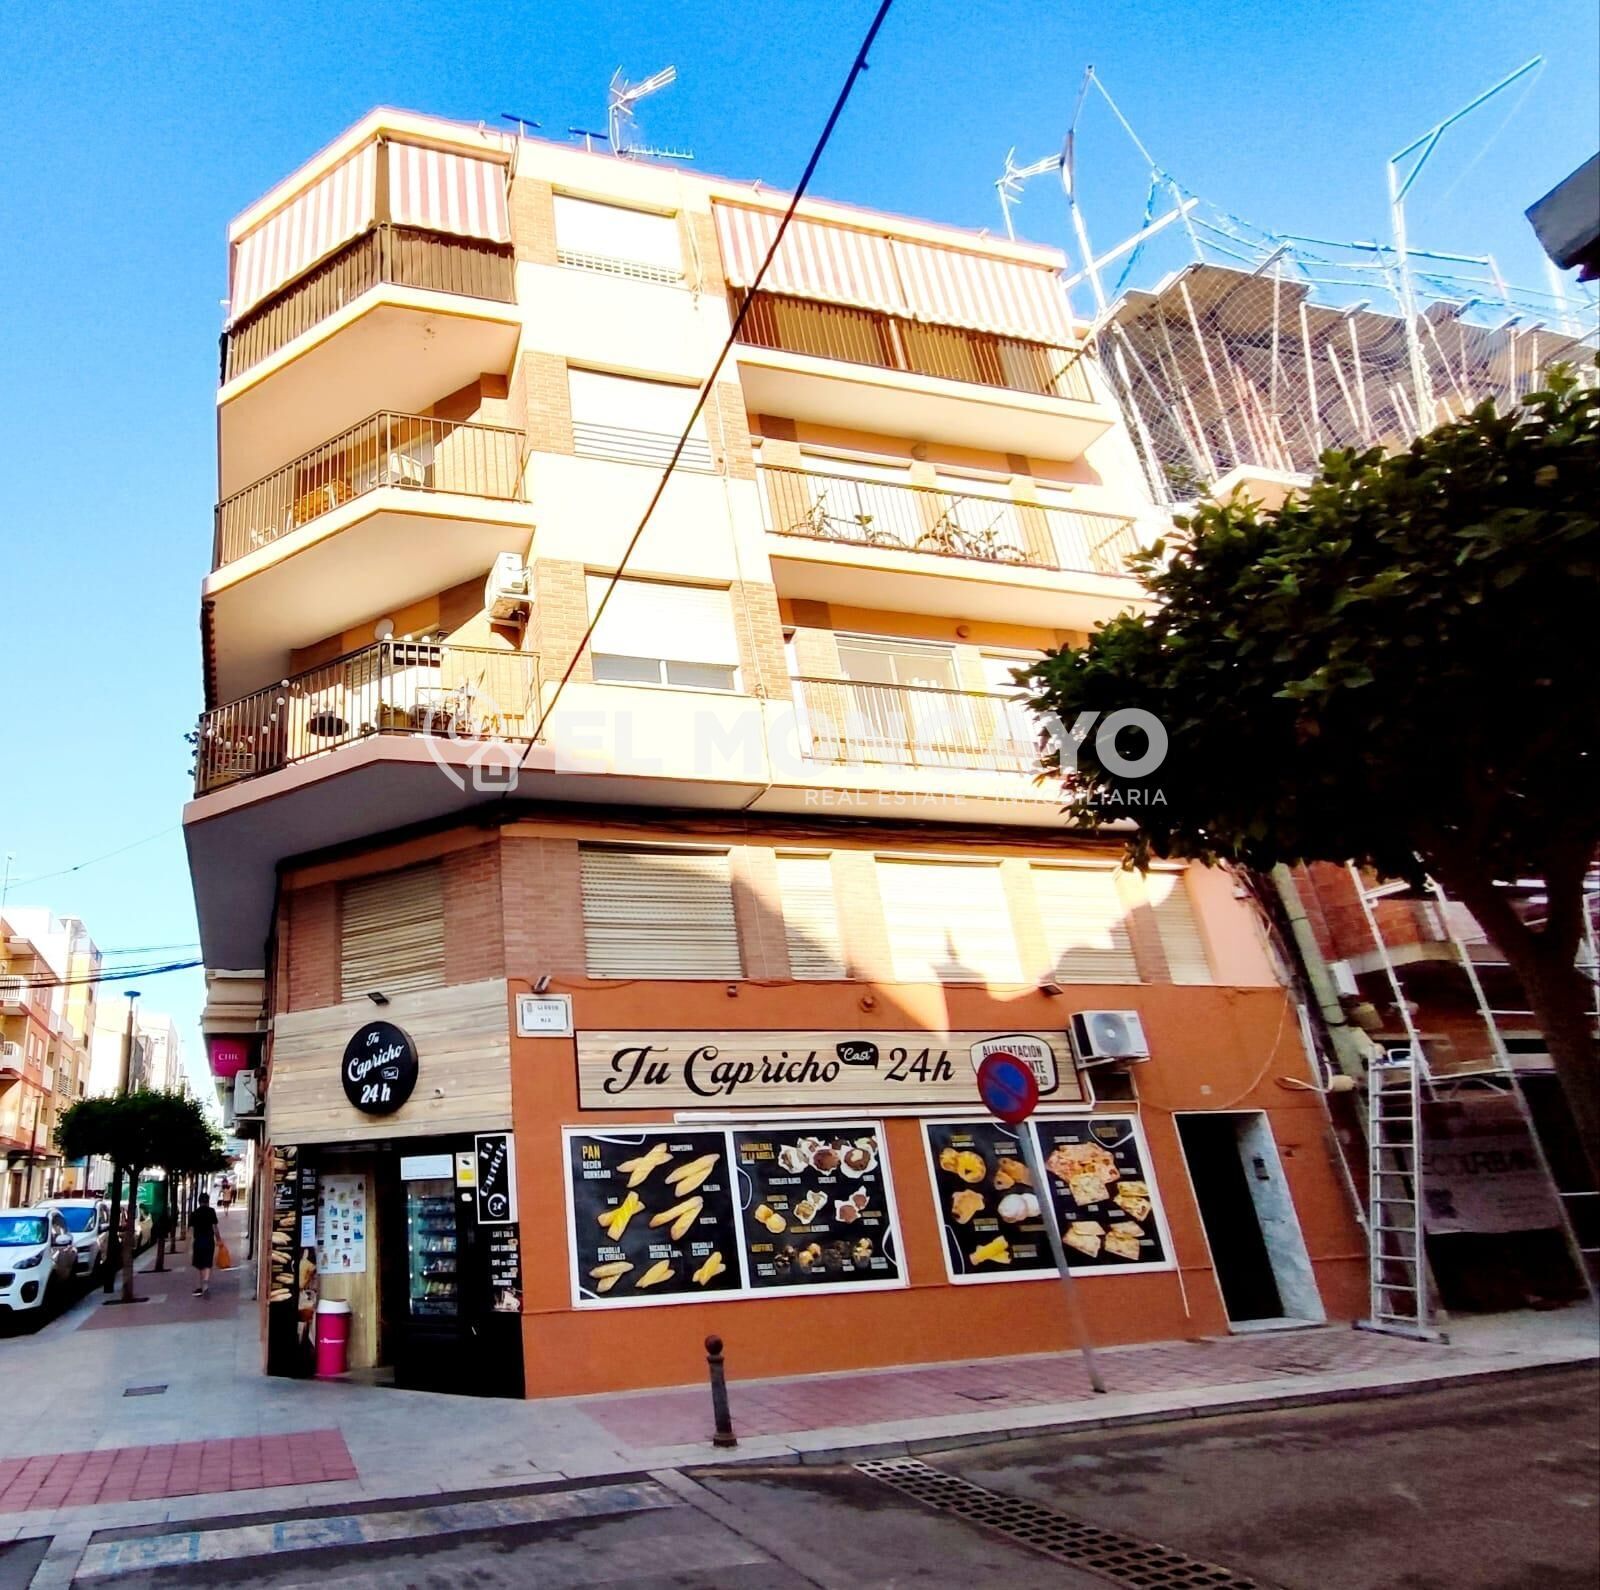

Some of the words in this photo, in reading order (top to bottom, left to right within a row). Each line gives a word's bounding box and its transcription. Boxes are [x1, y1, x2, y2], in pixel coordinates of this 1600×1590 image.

[347, 1043, 405, 1082] Capricho
[603, 1045, 672, 1095] Tu
[683, 1045, 841, 1097] Capricho
[884, 1047, 956, 1083] 24h
[360, 1083, 379, 1103] 24
[582, 1145, 601, 1160] PAN
